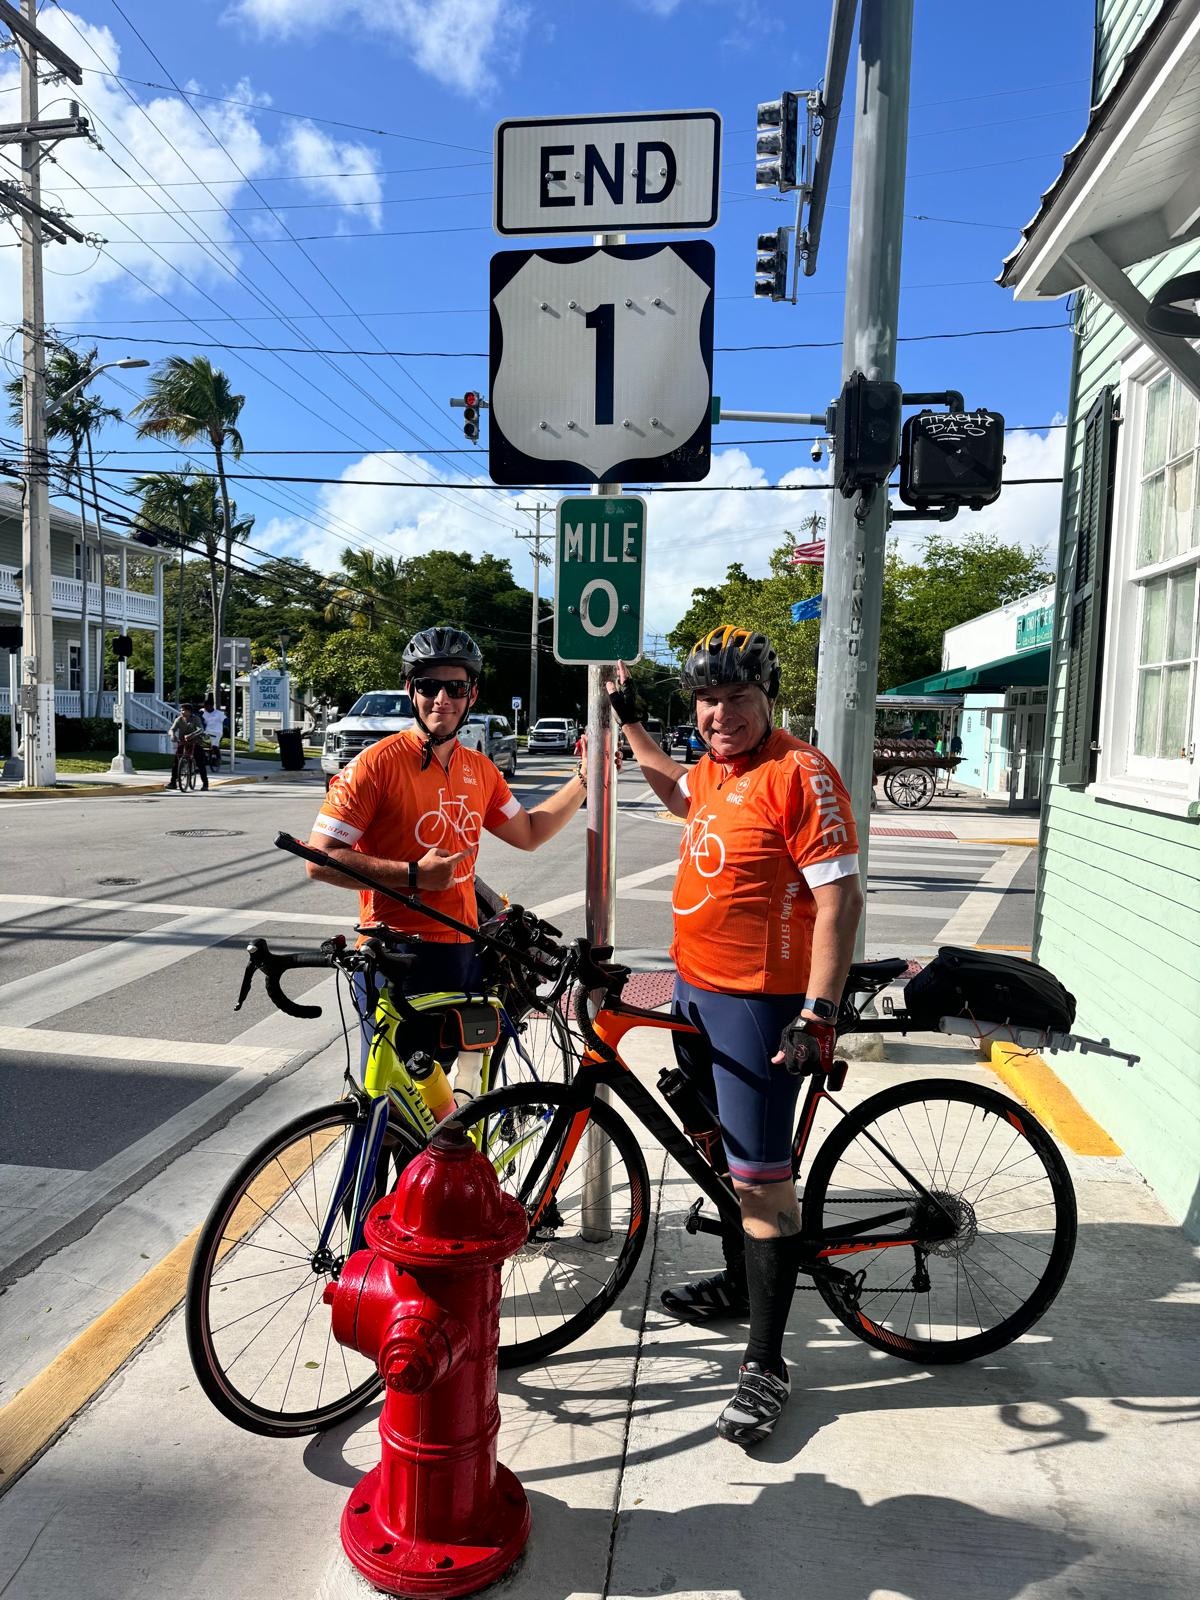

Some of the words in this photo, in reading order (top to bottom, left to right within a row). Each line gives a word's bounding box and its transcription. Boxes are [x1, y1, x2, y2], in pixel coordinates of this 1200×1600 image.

[539, 141, 677, 208] END
[585, 303, 615, 426] 1
[563, 522, 638, 564] MILE
[580, 578, 619, 638] 0
[725, 792, 745, 806] BIKE
[809, 774, 848, 847] BIKE
[781, 924, 791, 960] STAR
